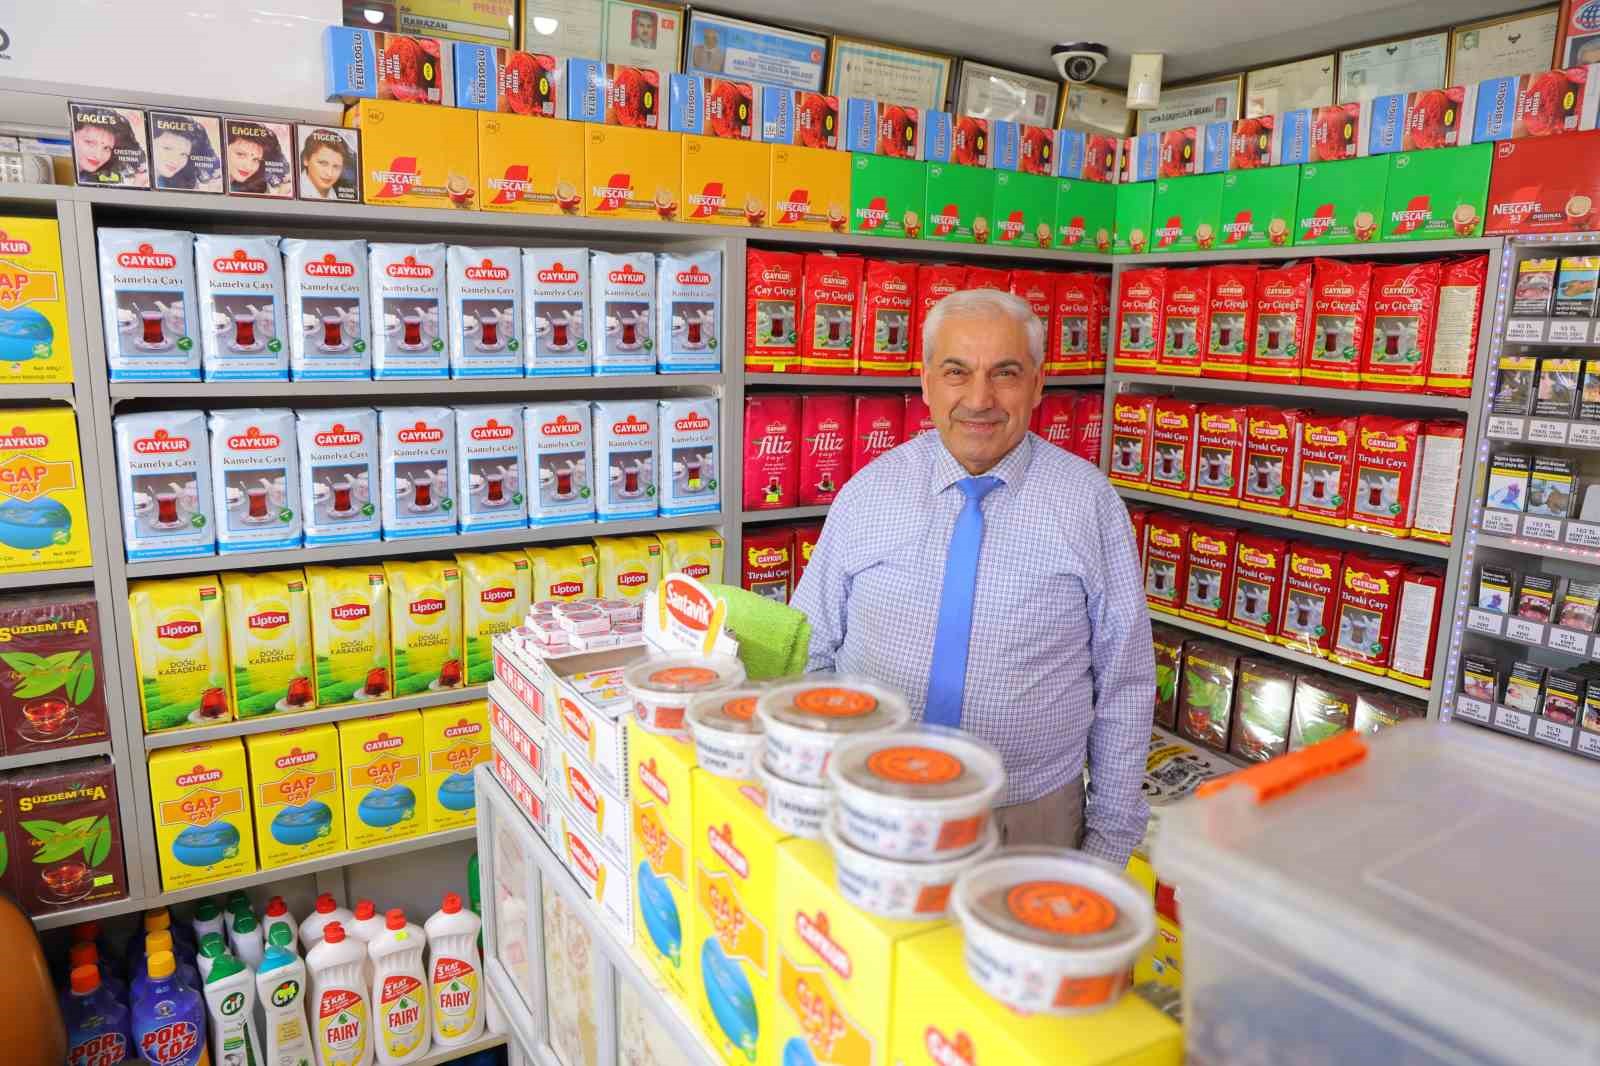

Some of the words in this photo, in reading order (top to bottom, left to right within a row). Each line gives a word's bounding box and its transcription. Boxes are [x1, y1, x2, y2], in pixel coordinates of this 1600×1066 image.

[1081, 422, 1101, 442] fili
[755, 435, 793, 459] filiz
[810, 432, 844, 456] filiz
[863, 430, 895, 454] filiz
[620, 574, 645, 584] Lipton
[483, 590, 513, 601] Lipton
[553, 585, 580, 595] Lipton
[334, 606, 367, 617] Lipton
[412, 602, 443, 613] Lipton
[58, 618, 88, 634] TEA
[251, 615, 287, 626] Lipton
[160, 624, 198, 636] Lipton
[447, 746, 480, 762] GAP
[367, 761, 401, 777] GAP
[78, 785, 106, 801] TEA
[280, 776, 316, 794] GAP
[181, 796, 221, 813] GAP
[437, 965, 444, 976] 3
[384, 985, 392, 997] 3
[321, 999, 330, 1010] 3
[440, 991, 471, 1008] FAIRY
[388, 1006, 419, 1028] FAIRY
[141, 1022, 188, 1050] POR
[327, 1021, 359, 1043] FAIRY
[69, 1033, 115, 1065] POR
